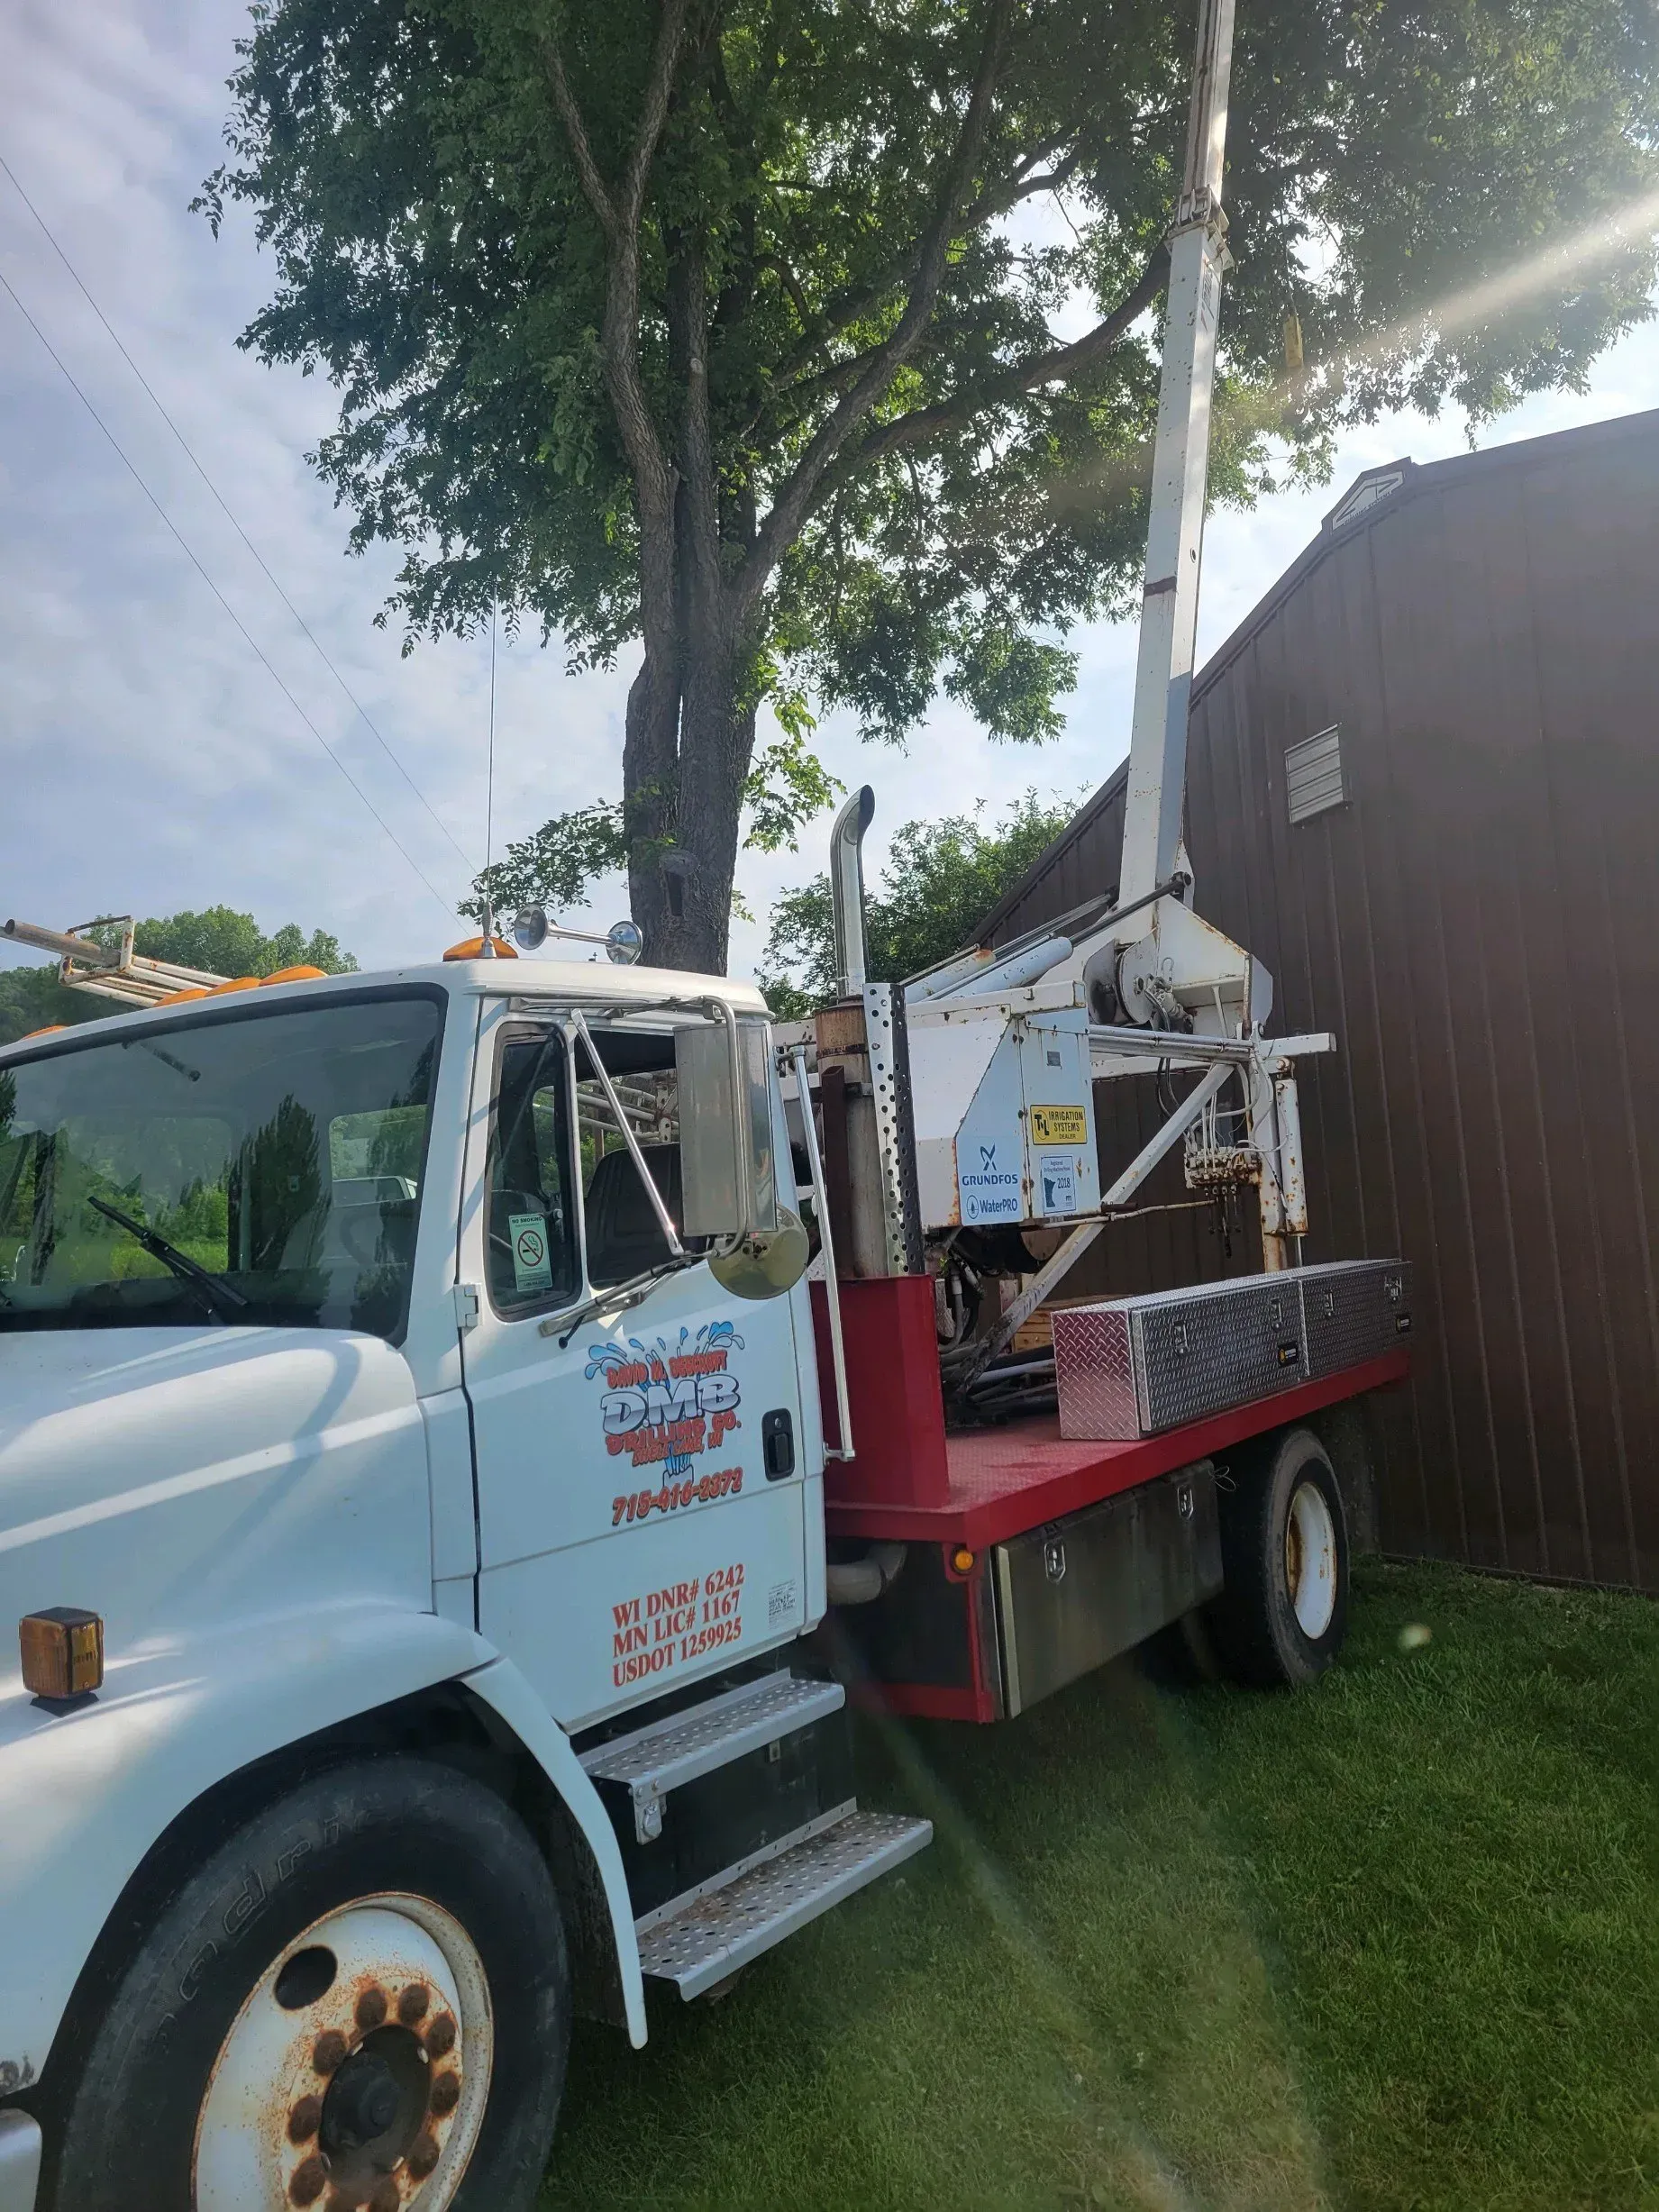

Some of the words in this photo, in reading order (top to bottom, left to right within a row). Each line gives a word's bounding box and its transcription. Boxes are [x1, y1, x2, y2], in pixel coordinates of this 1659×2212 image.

[1048, 1110, 1084, 1122] IRRIGATION
[1053, 1122, 1080, 1133] SYSTEMS
[962, 1173, 1018, 1187] GRUNDFOS
[1057, 1177, 1071, 1188] 2018
[980, 1198, 1018, 1214] WaterPRO
[606, 1362, 649, 1389] DAVID
[606, 1416, 706, 1456] DRILLING
[712, 1409, 742, 1432] CO.
[707, 1430, 724, 1449] WI
[612, 1598, 641, 1629] WI
[646, 1578, 699, 1618] DNR#
[705, 1562, 745, 1597] 6242
[613, 1623, 648, 1658] MN
[654, 1606, 696, 1643] LIC#
[702, 1588, 741, 1625] 1167
[613, 1642, 676, 1688] USDOT
[680, 1616, 742, 1662] 1259925
